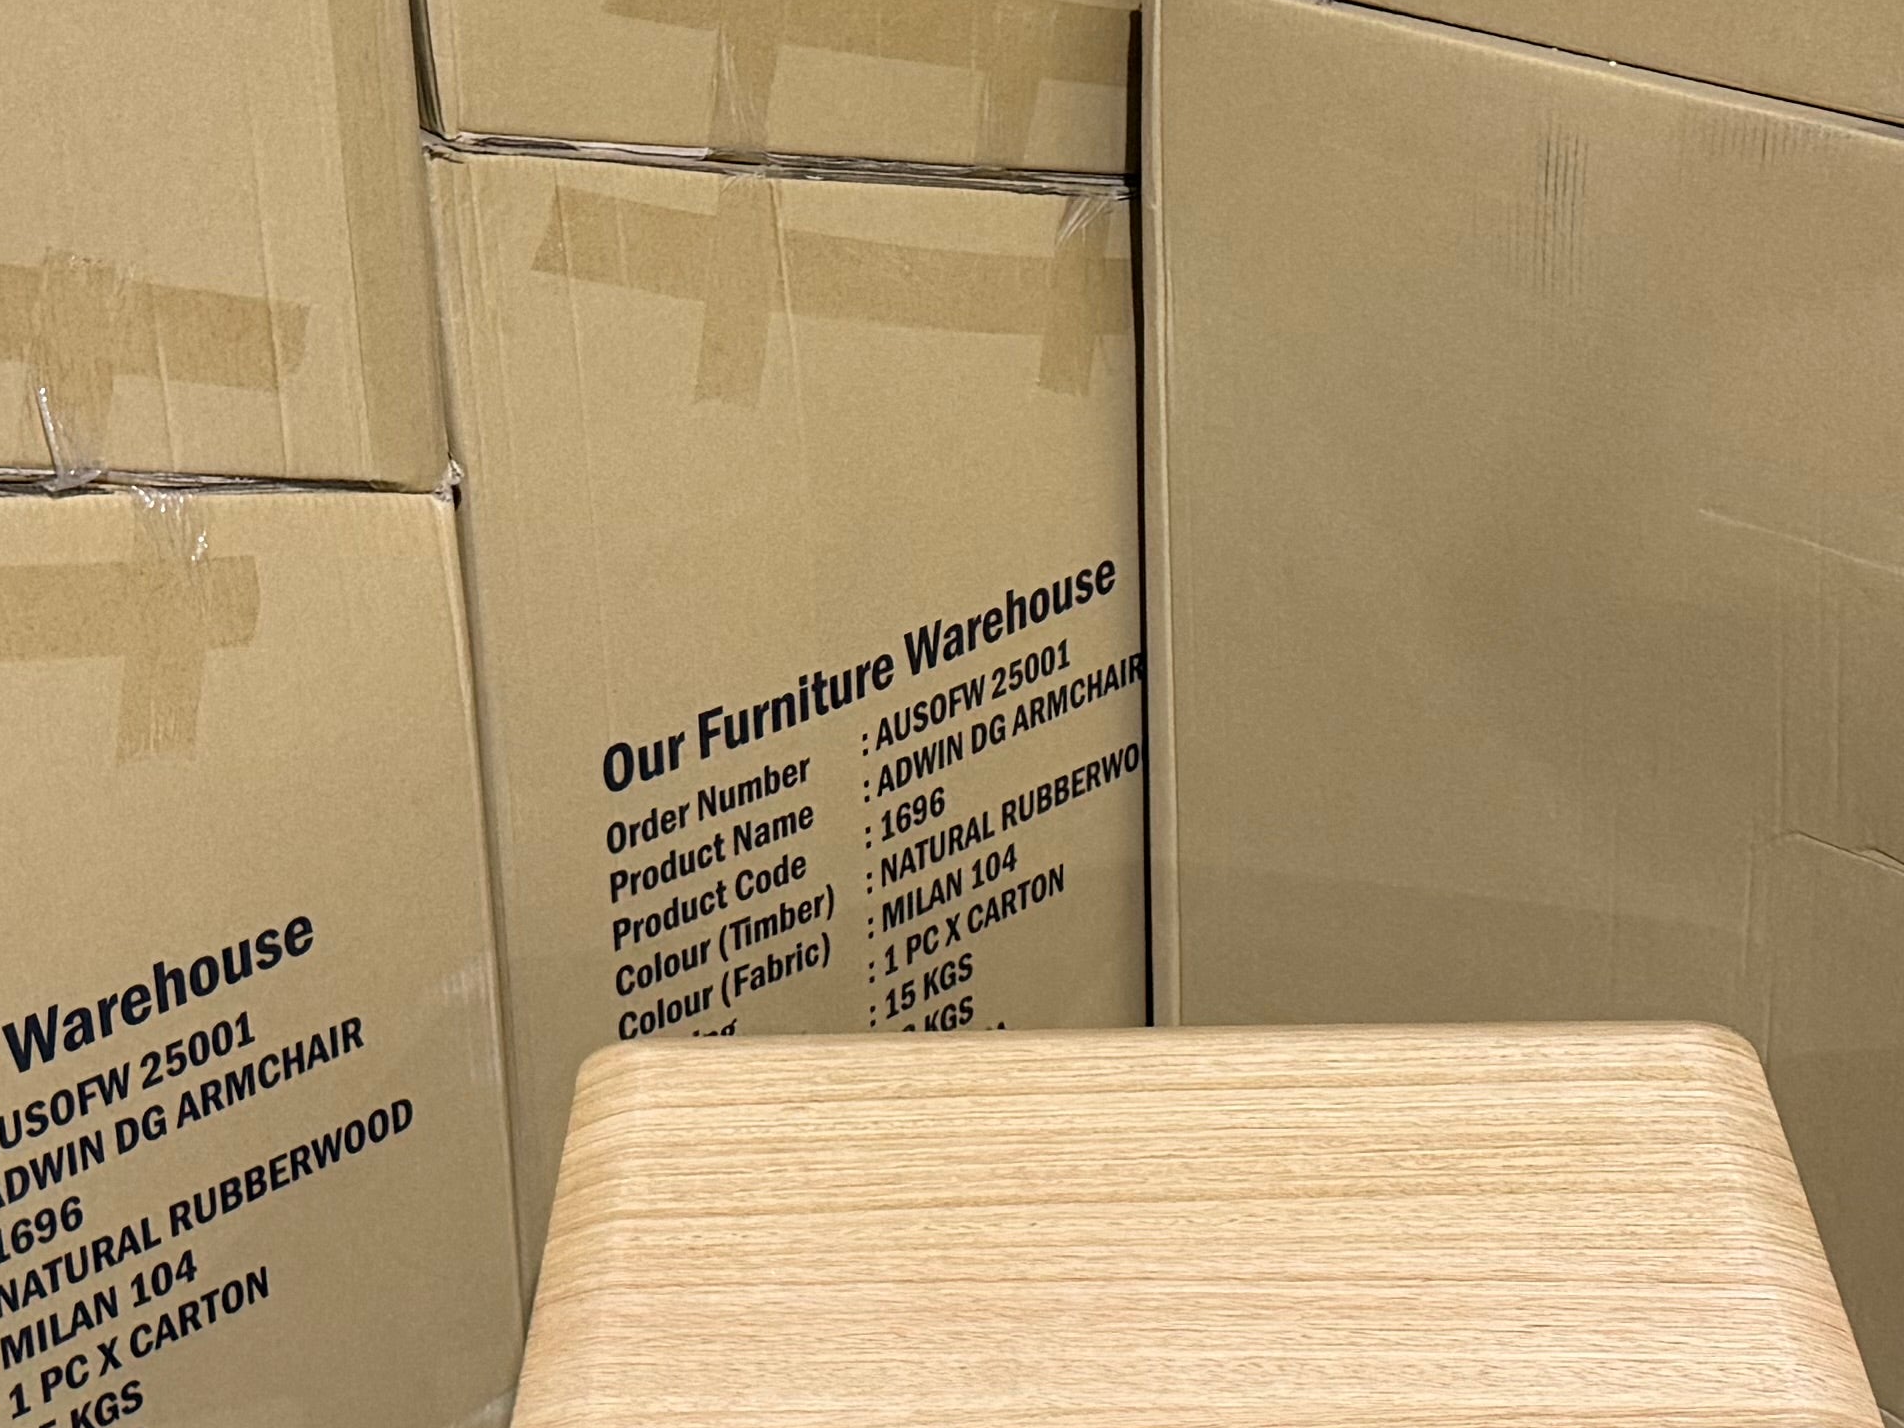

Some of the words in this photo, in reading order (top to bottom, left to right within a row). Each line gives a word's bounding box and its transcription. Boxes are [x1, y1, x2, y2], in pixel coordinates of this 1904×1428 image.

[602, 731, 686, 793] Our
[697, 653, 895, 760] Furniture
[903, 559, 1116, 676] Warehouse
[606, 802, 691, 855] Order
[697, 757, 811, 822] Number
[875, 674, 986, 751] AUSOFW
[991, 639, 1071, 700] 25001
[609, 832, 726, 904] Product
[732, 805, 814, 856] Name
[876, 731, 964, 798] ADWIN
[970, 713, 1006, 755] DG
[1011, 651, 1145, 737] ARMCHAIR
[612, 880, 728, 952] Product
[734, 854, 807, 902] Code
[881, 786, 946, 842] 1696
[617, 985, 714, 1041] Colour
[720, 931, 831, 1009] (Fabric)
[881, 868, 963, 933] MILAN
[971, 843, 1018, 890] 104
[1, 915, 314, 1073] Warehouse
[139, 1011, 256, 1090] 25001
[168, 1098, 413, 1238] RUBBERWOOD
